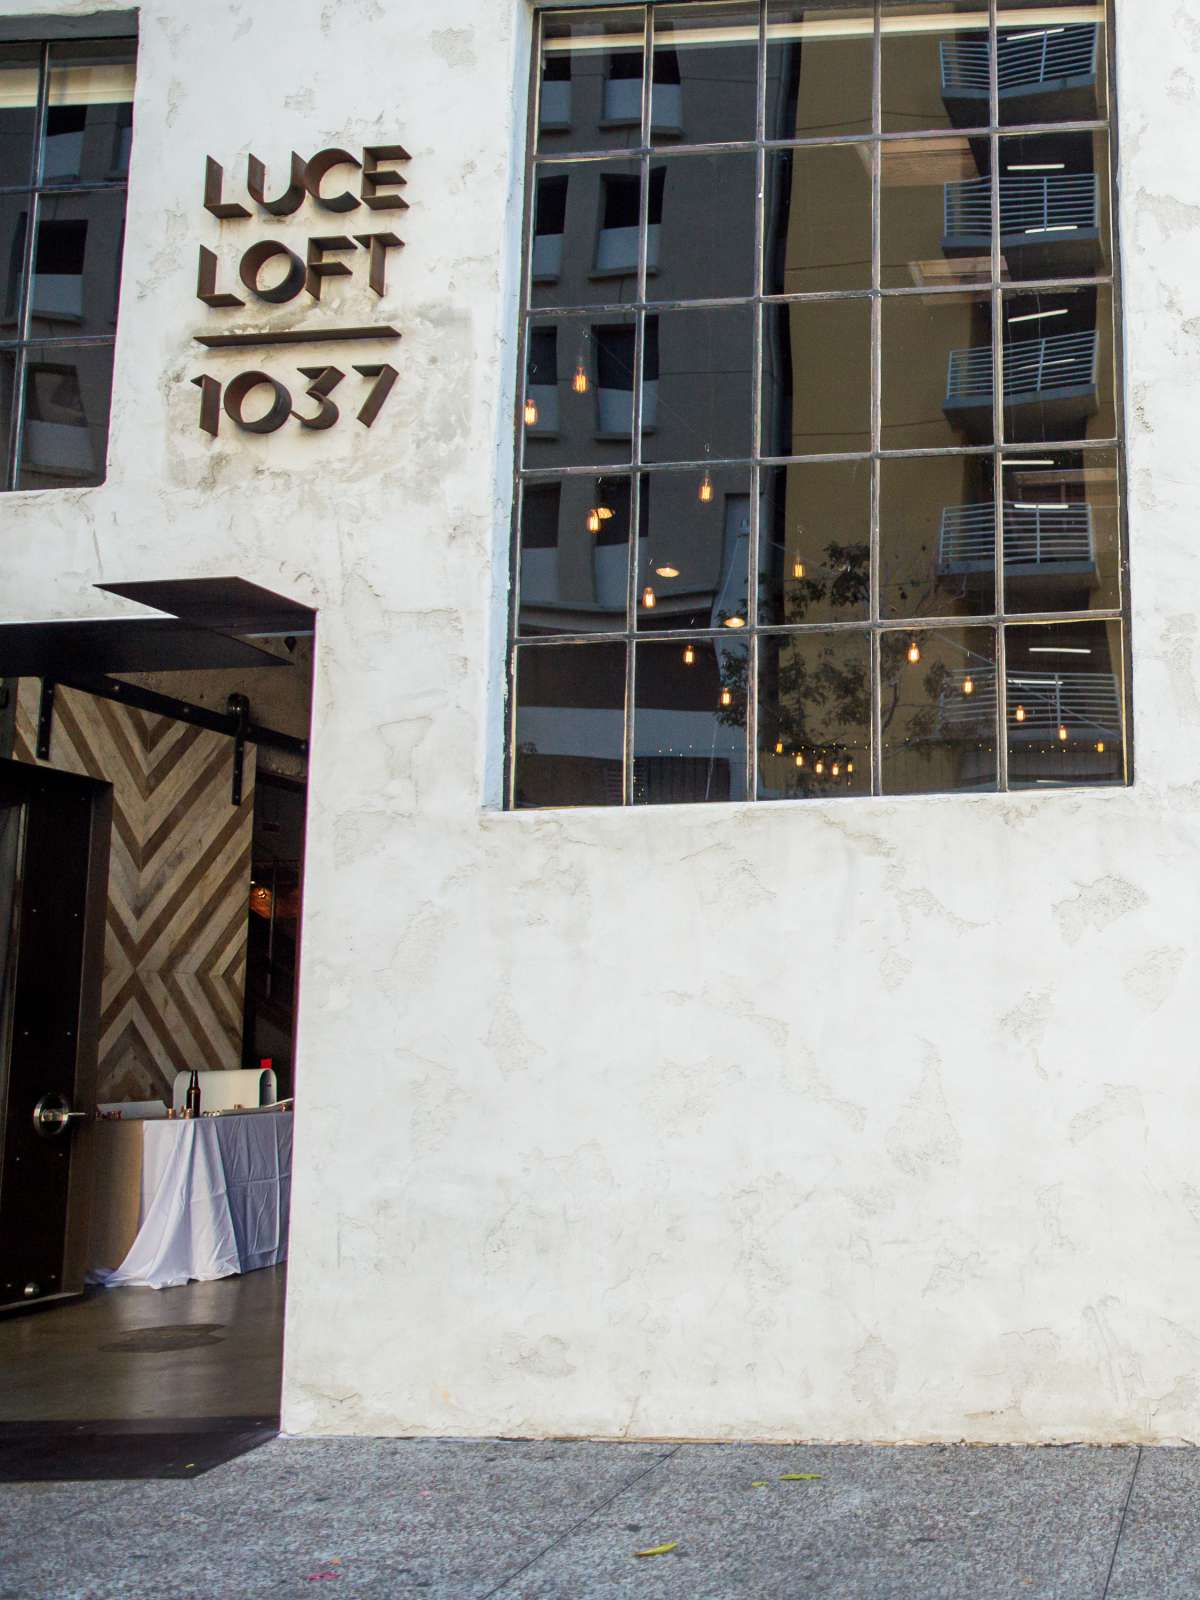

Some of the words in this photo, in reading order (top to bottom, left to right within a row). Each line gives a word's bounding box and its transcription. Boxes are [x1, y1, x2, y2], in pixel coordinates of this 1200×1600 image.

[204, 145, 412, 219] LUCE
[197, 232, 405, 308] LOFT
[190, 363, 399, 437] 1037
